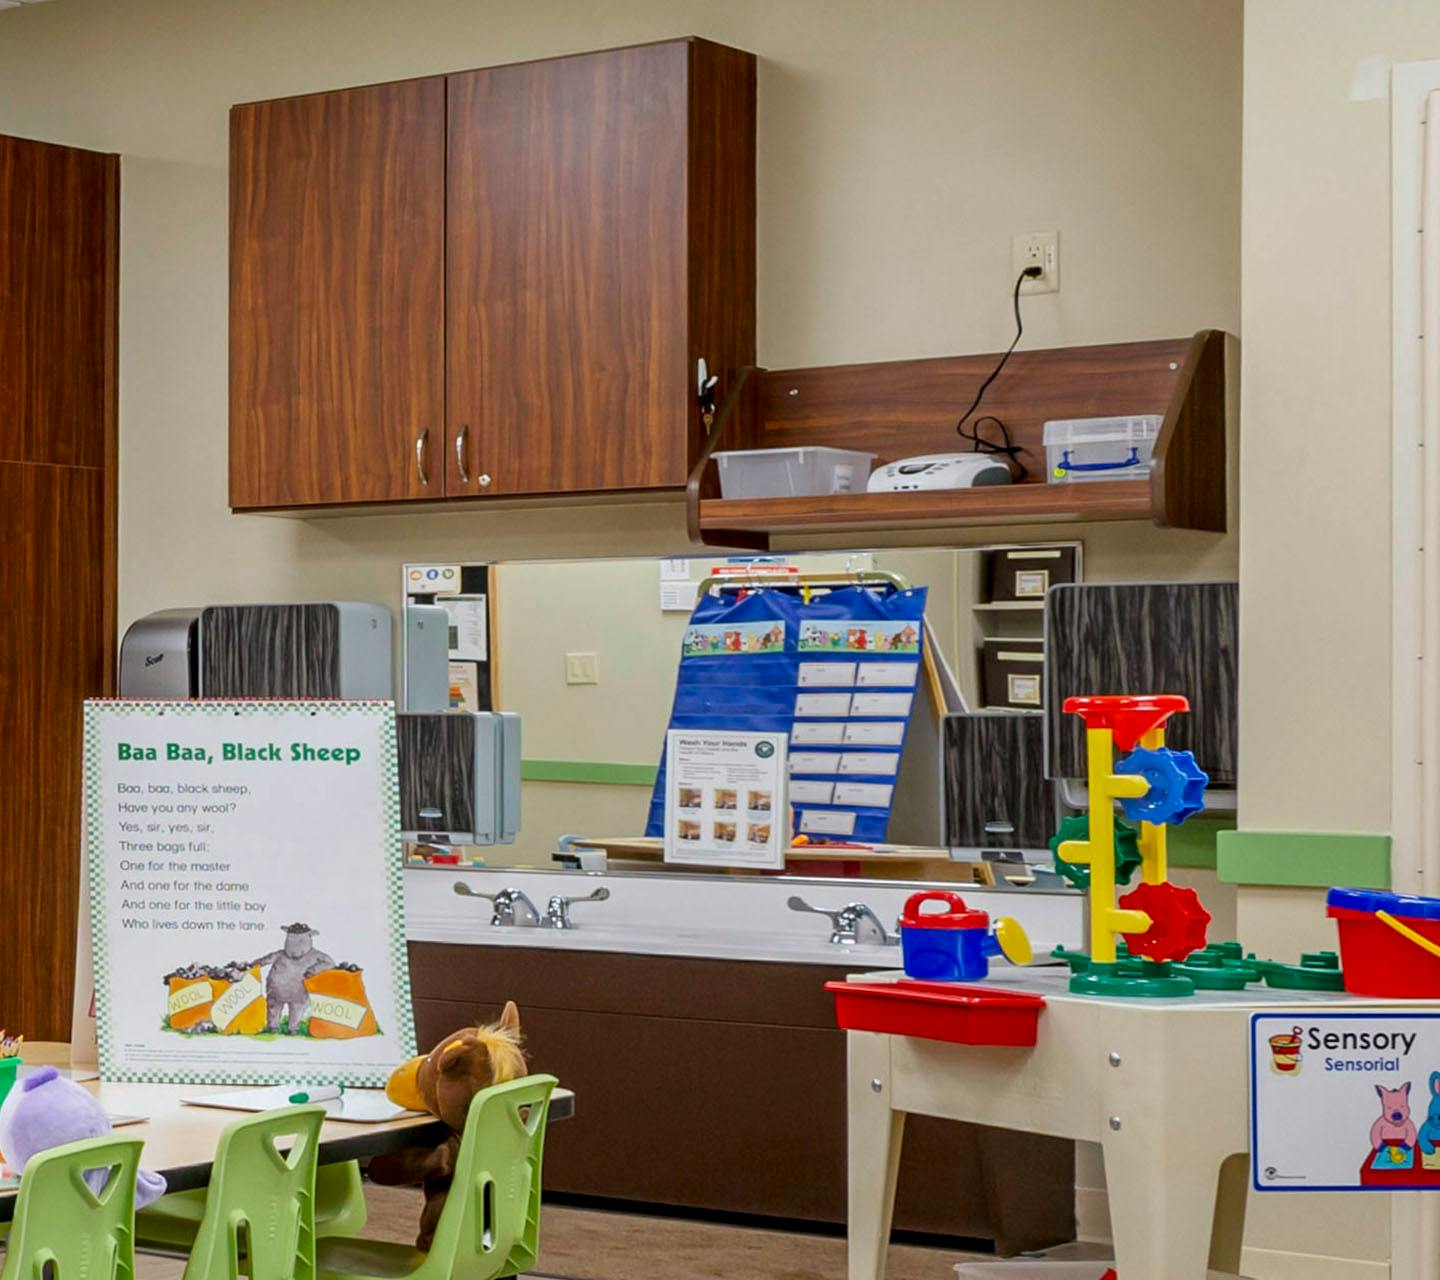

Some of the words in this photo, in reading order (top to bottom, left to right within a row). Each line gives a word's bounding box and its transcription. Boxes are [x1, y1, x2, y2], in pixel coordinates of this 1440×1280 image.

[117, 742, 158, 761] Baa
[166, 742, 214, 765] Baa,
[222, 742, 283, 762] Black
[290, 742, 361, 766] Sheep
[117, 783, 144, 795] Baa,
[147, 783, 173, 795] baa,
[177, 783, 209, 795] black
[118, 802, 148, 813] Have
[151, 803, 174, 816] you
[176, 803, 198, 816] any
[202, 802, 237, 814] wool?
[119, 821, 143, 833] Yes,
[169, 823, 193, 835] yes,
[119, 841, 154, 852] Three
[156, 841, 186, 854] bags
[119, 860, 145, 871] One
[148, 860, 164, 871] for
[168, 860, 188, 872] the
[191, 862, 231, 872] master
[120, 879, 145, 891] And
[147, 881, 170, 891] one
[173, 880, 190, 891] for
[194, 880, 213, 891] the
[215, 881, 249, 892] dame
[121, 899, 146, 910] And
[148, 901, 171, 911] one
[174, 900, 191, 911] for
[194, 900, 213, 911] the
[216, 900, 241, 911] little
[244, 901, 267, 913] boy
[121, 918, 150, 929] Who
[152, 919, 179, 930] lives
[181, 919, 214, 930] down
[217, 920, 236, 931] the
[170, 990, 205, 1012] WOOL
[217, 981, 253, 1015] WOOL
[313, 1000, 352, 1020] WOOL
[1307, 1027, 1417, 1056] Sensory
[1324, 1057, 1400, 1071] Sensorial
